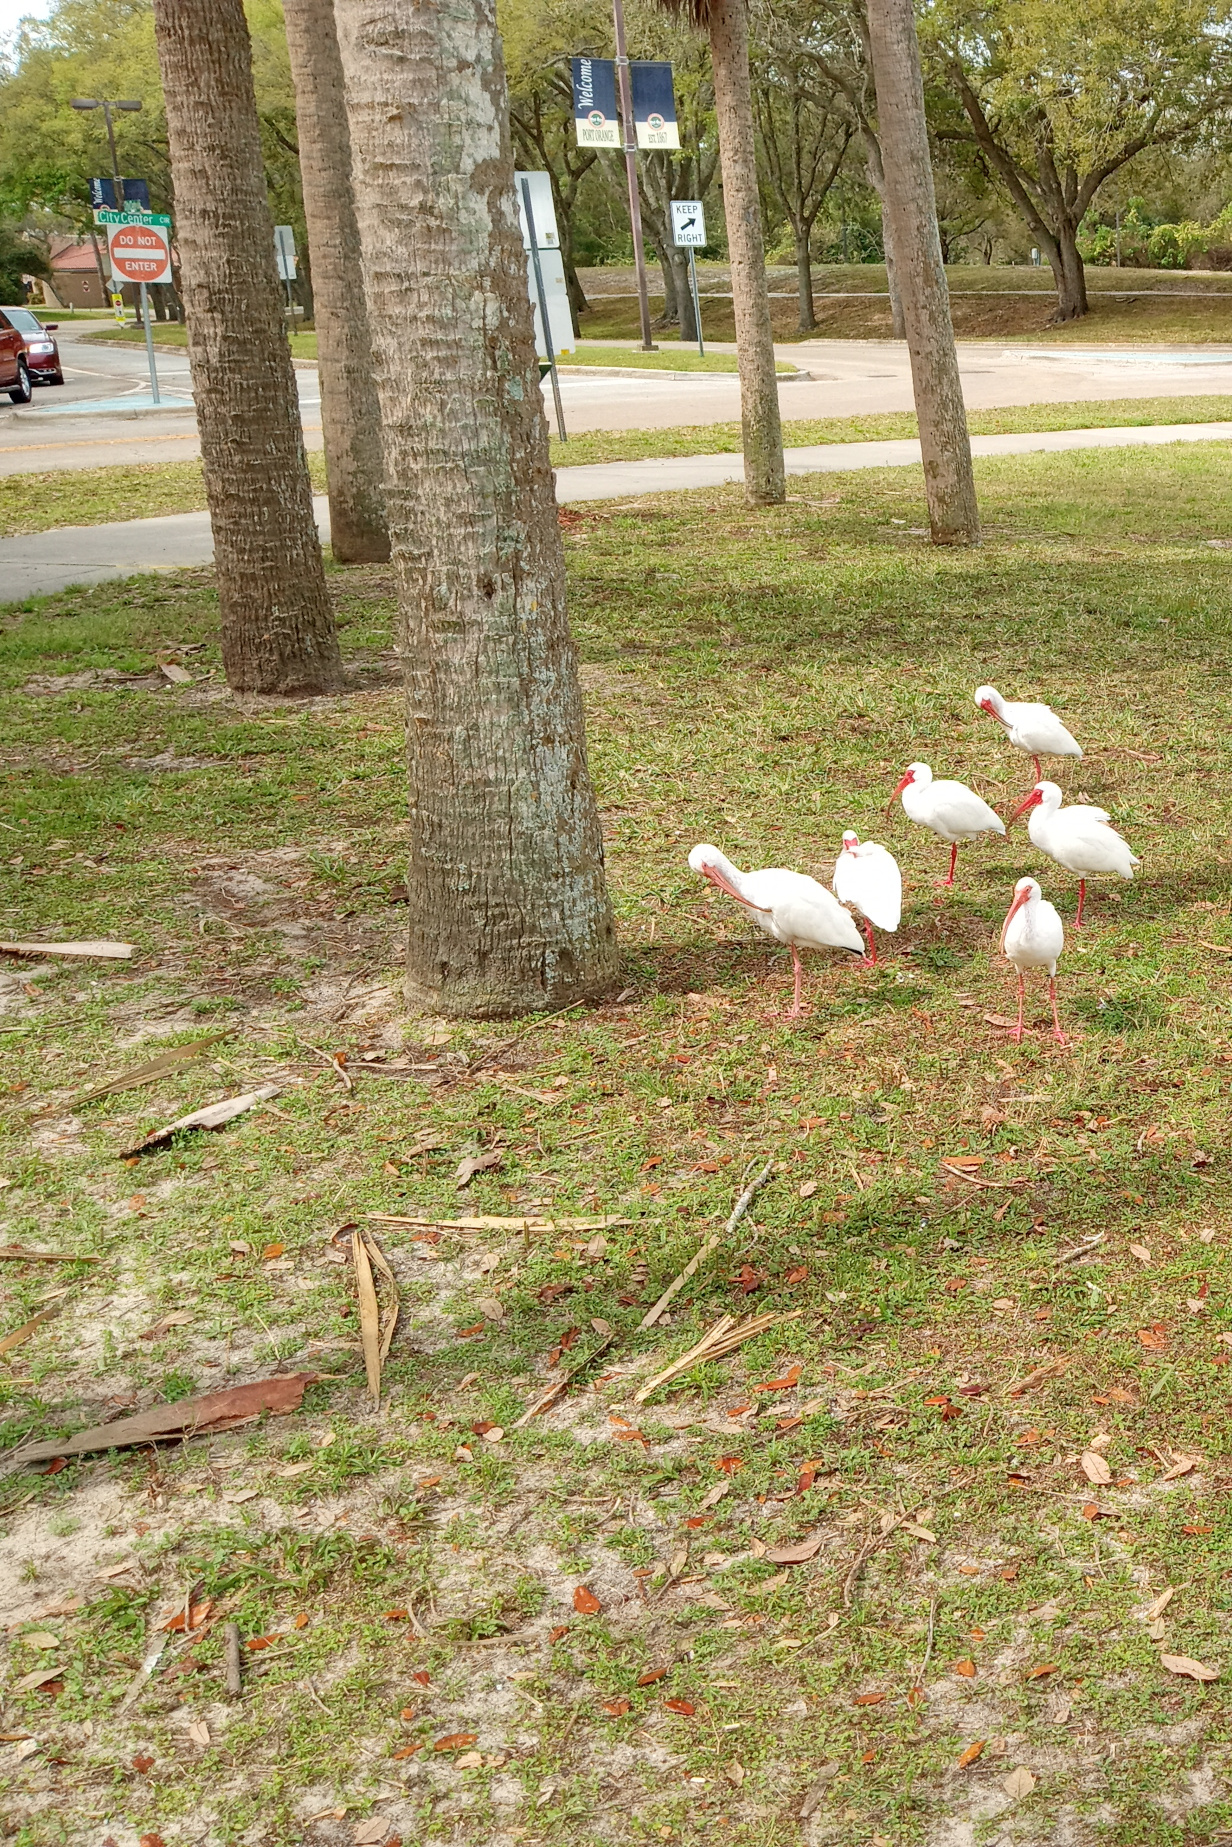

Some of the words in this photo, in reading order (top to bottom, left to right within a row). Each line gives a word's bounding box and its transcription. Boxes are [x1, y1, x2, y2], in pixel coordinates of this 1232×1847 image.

[575, 58, 594, 109] Welcome
[582, 128, 595, 141] PORT
[595, 129, 615, 142] ORANGE
[676, 205, 698, 213] KEEP
[119, 236, 133, 245] DO
[137, 237, 156, 246] NOT
[677, 234, 702, 242] RIGHT
[125, 261, 157, 271] ENTER
